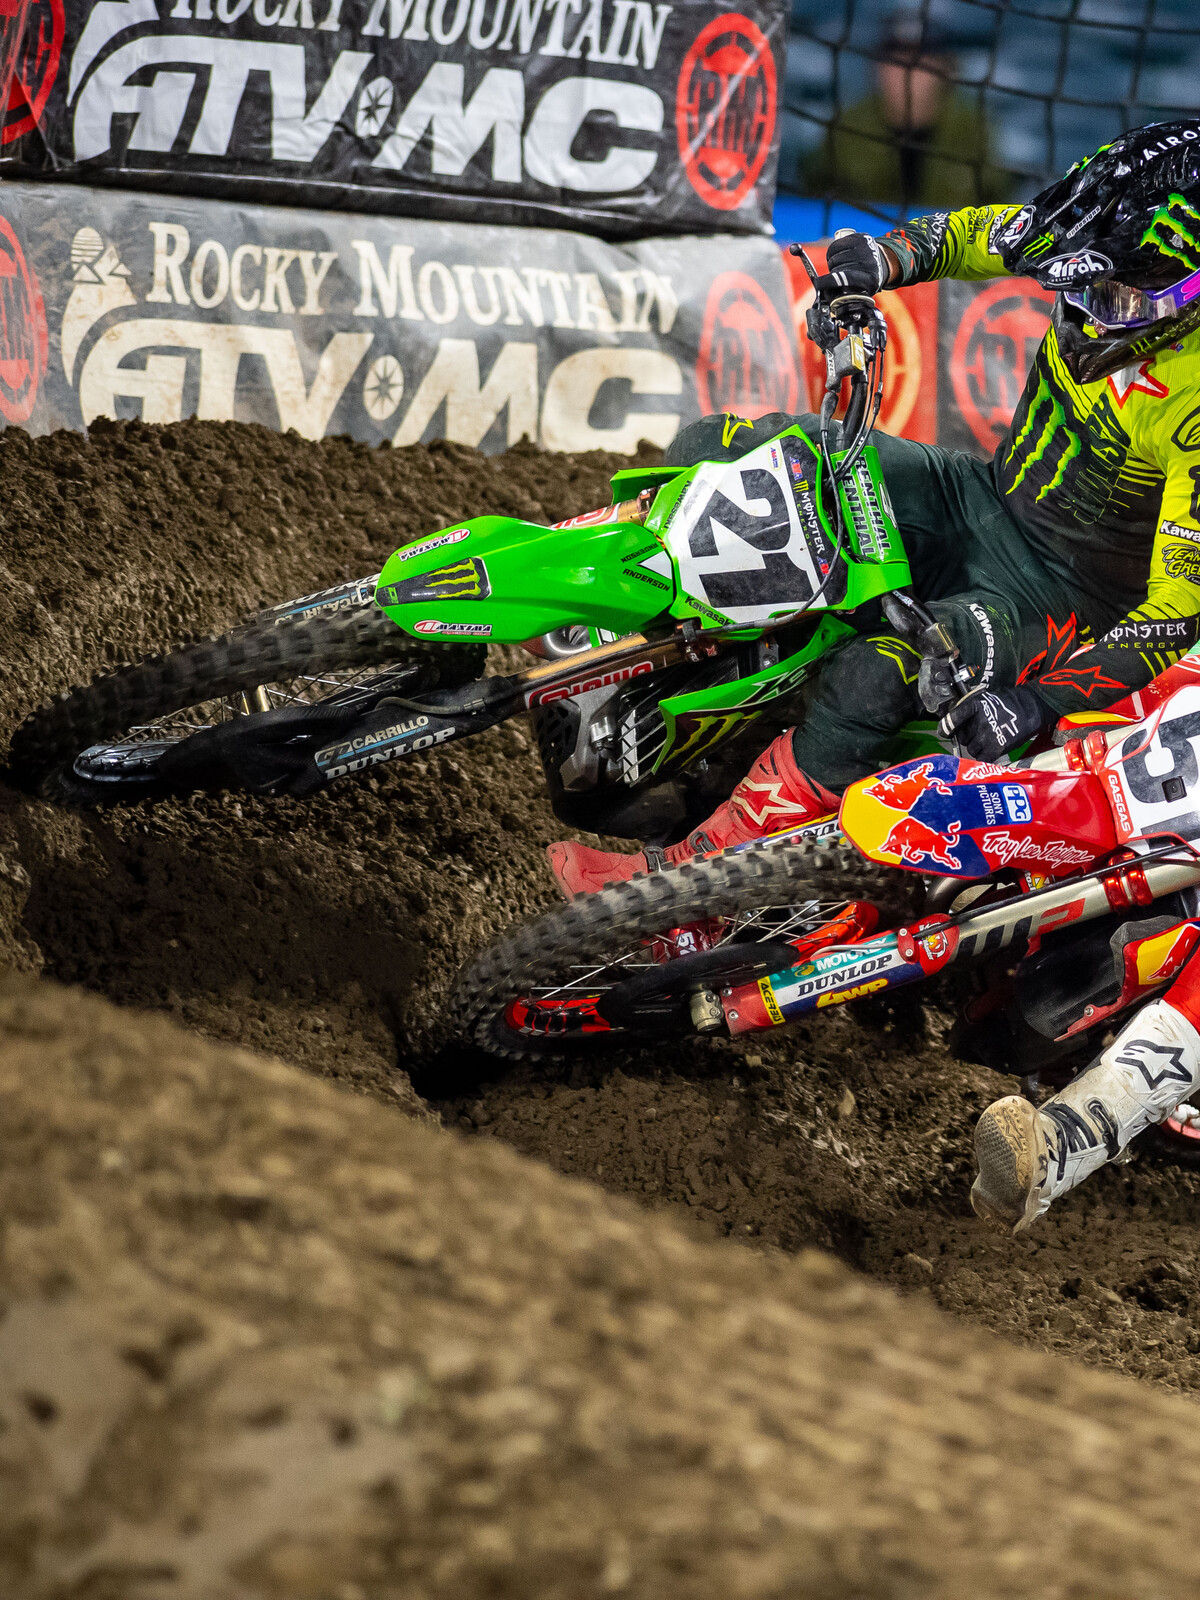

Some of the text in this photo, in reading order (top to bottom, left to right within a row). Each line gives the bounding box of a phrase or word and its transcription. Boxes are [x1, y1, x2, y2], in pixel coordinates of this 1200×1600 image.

[146, 222, 338, 316] ROCKY
[351, 239, 678, 334] MOUNTAIN
[664, 480, 693, 529] Kawasaki
[800, 491, 826, 554] MONSTER
[853, 453, 892, 550] RENTHAL
[620, 542, 659, 564] ANDERSON
[622, 568, 671, 592] ANDERSON
[684, 595, 737, 627] Kawasak
[968, 602, 996, 690] Kawasaki
[1107, 641, 1176, 650] ENERGY
[354, 715, 429, 751] CARRILLO
[980, 698, 1007, 746] ASTARS
[324, 727, 456, 781] DUNLOP
[976, 785, 998, 826] PICTURES
[990, 792, 1005, 816] SONY
[1107, 773, 1131, 833] GASGAS
[796, 953, 893, 998] DUNLOP
